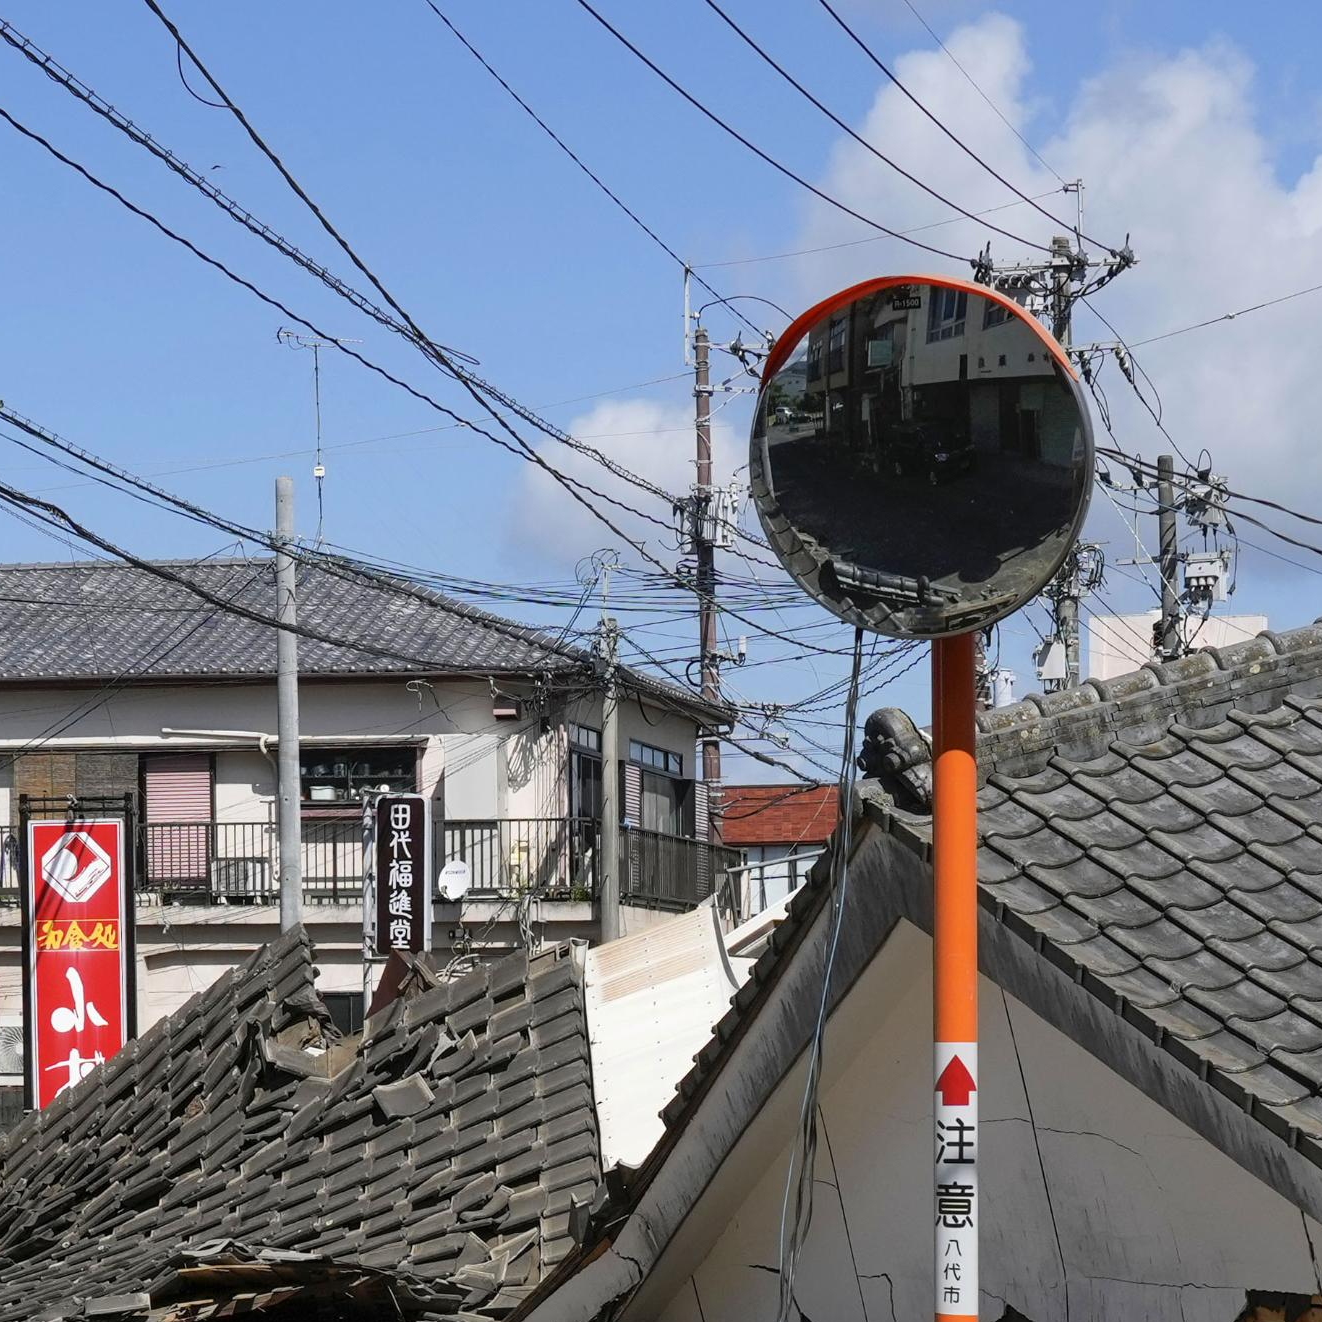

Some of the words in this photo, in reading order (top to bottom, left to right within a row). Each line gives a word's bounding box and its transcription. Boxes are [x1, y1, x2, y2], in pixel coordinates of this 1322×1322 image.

[388, 803, 414, 950] 田代福進堂
[37, 919, 119, 951] 和食処
[935, 1118, 976, 1229] 注意
[943, 1239, 962, 1304] 八代市
